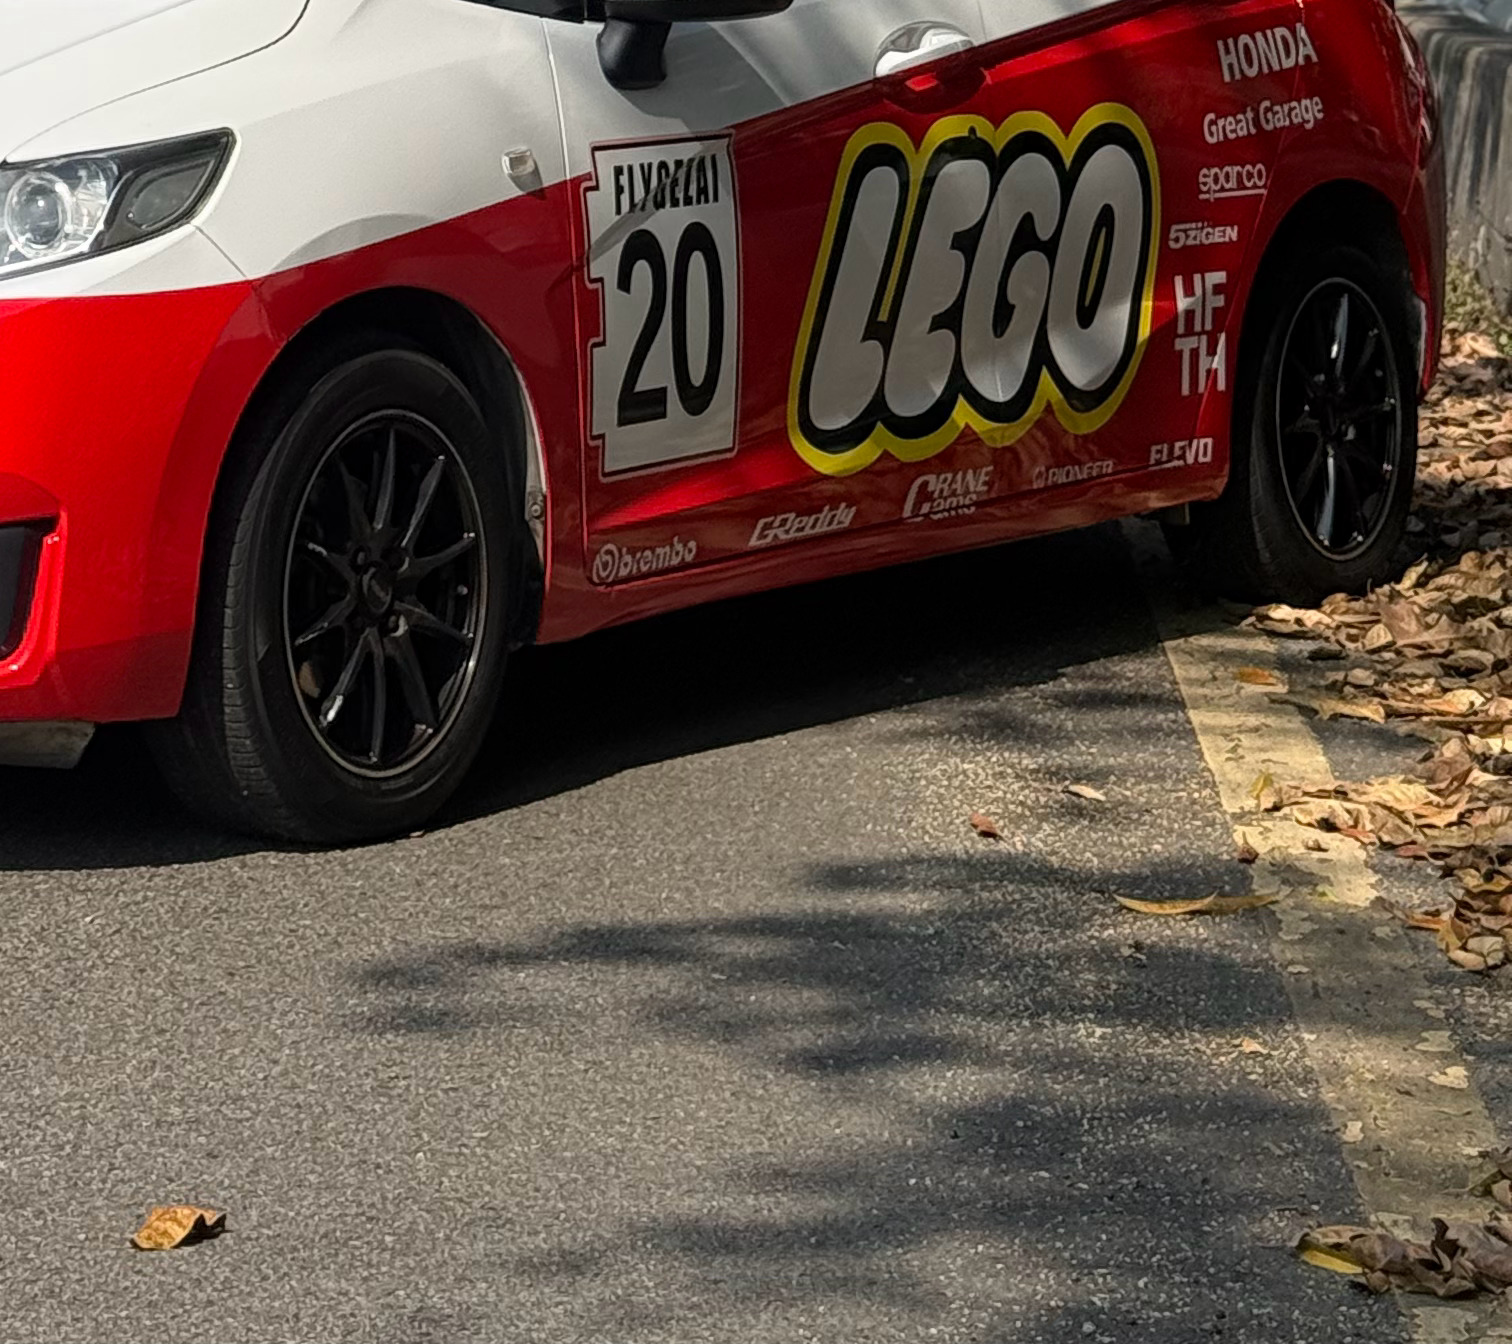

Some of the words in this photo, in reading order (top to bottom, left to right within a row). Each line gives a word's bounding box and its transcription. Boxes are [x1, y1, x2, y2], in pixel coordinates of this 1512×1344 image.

[1216, 22, 1319, 83] HONDA
[1203, 106, 1257, 144] Great
[1259, 96, 1324, 130] Garage
[1199, 163, 1267, 201] sparco
[802, 136, 1150, 438] LEGO
[1174, 271, 1227, 335] HF
[616, 221, 725, 427] 20
[1174, 333, 1226, 396] TH
[617, 535, 697, 577] brembo
